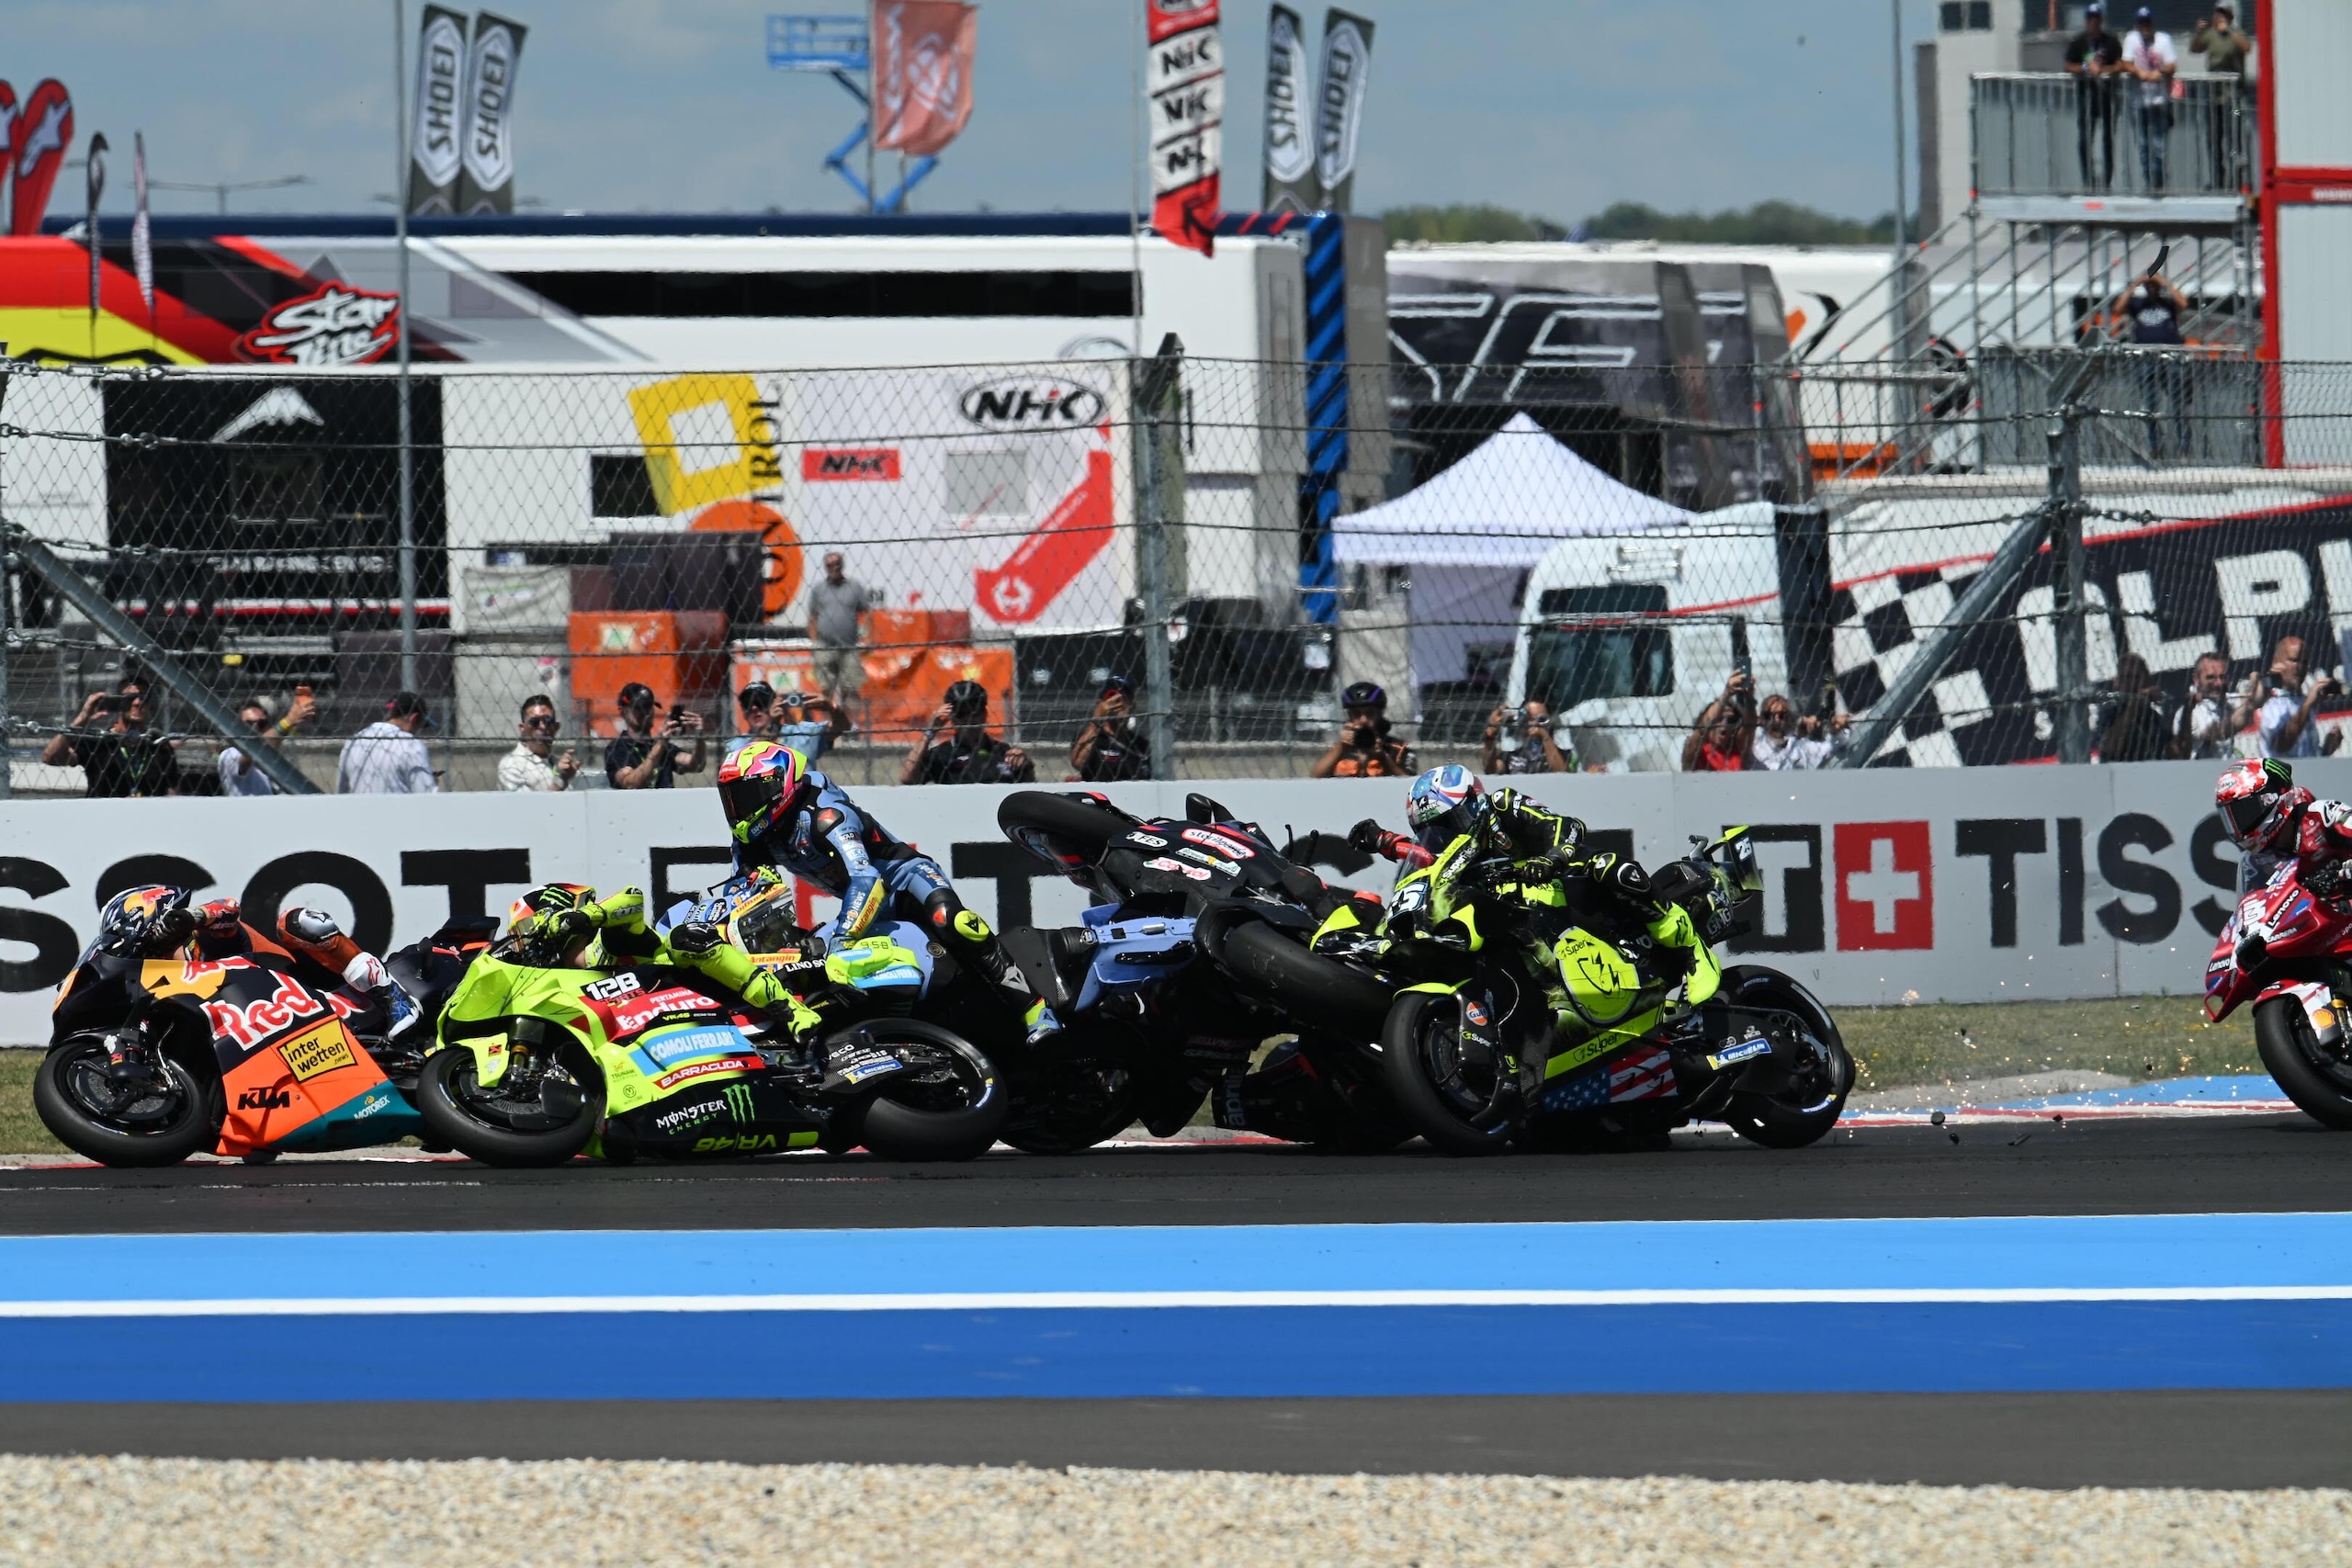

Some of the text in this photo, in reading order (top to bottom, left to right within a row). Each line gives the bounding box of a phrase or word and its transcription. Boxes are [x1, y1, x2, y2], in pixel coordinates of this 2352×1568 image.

[426, 44, 455, 153] SHOEI
[475, 52, 506, 160] SHOEI
[1268, 44, 1298, 149] SHOEI
[1321, 48, 1352, 155] SHOEI
[2267, 888, 2300, 927] Lenovo
[750, 954, 797, 964] Antangin
[785, 960, 813, 974] LINO
[585, 971, 641, 1002] 12B
[649, 988, 695, 1005] PERTAMINA
[199, 969, 324, 1051] Red
[616, 996, 716, 1032] Enduro
[286, 1037, 321, 1064] inter
[297, 1041, 345, 1074] wetten
[649, 1030, 736, 1063] COMOLI FERRARI
[1727, 1042, 1767, 1061] MICHELIN
[660, 1058, 746, 1089] BARRACUDA
[237, 1086, 291, 1111] KTM
[353, 1094, 391, 1121] MOTOREX
[655, 1099, 728, 1130] MONSTER
[668, 1111, 719, 1136] ENERGY
